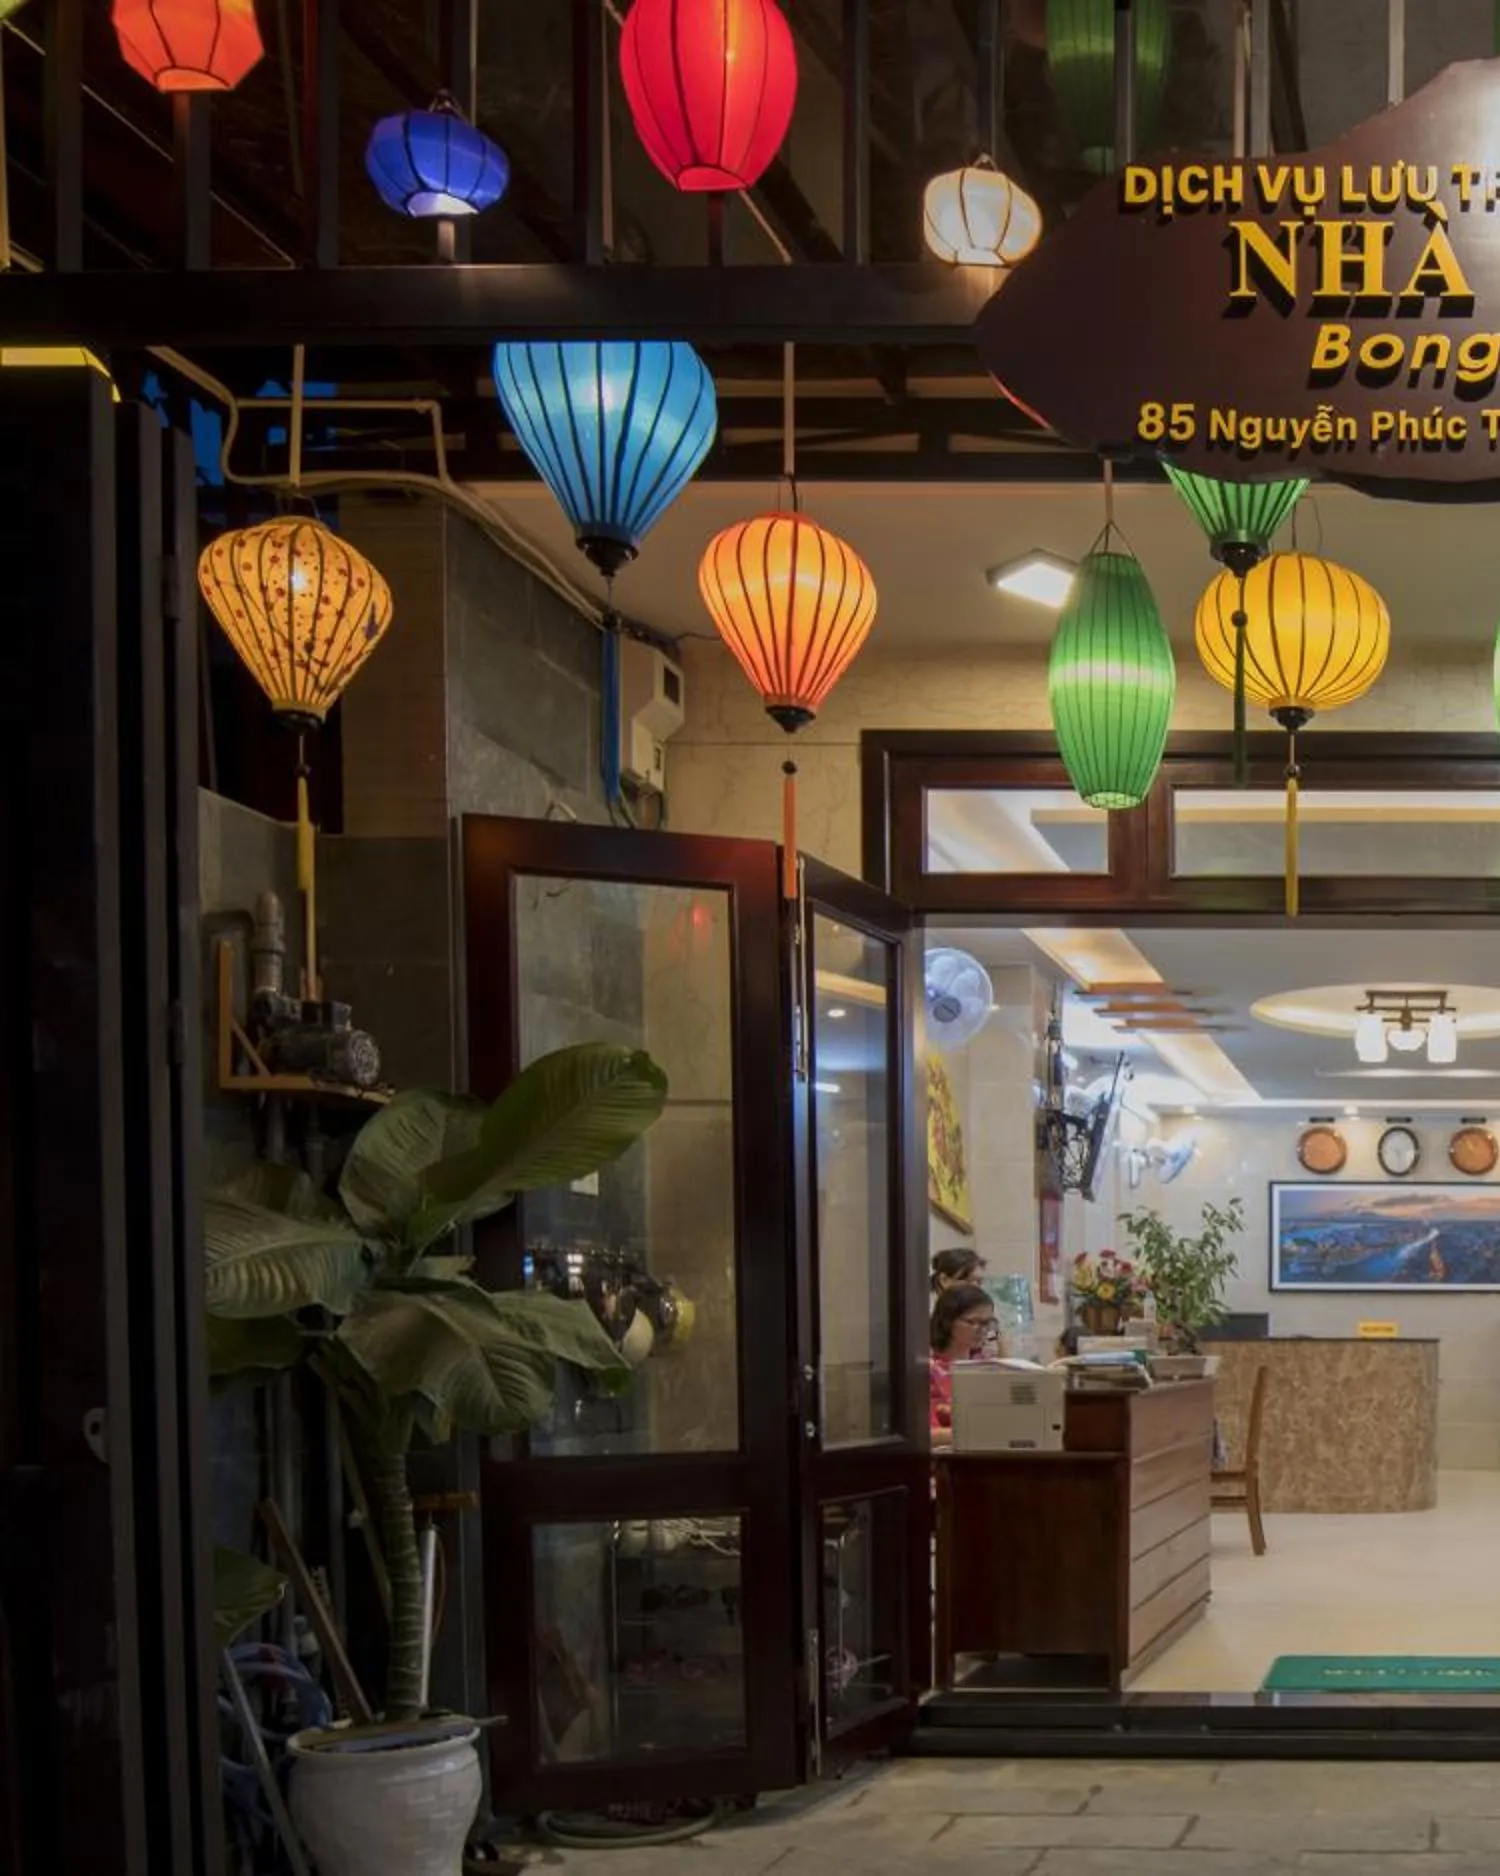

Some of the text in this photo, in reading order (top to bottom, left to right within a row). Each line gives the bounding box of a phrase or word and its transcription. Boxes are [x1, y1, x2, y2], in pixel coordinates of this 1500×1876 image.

[1124, 165, 1243, 215] DỊCH
[1257, 165, 1326, 216] VỤ
[1229, 201, 1474, 297] NHÀ
[1137, 402, 1196, 440] 85
[1210, 405, 1357, 449] Nguyễn
[1371, 407, 1467, 441] Phúc
